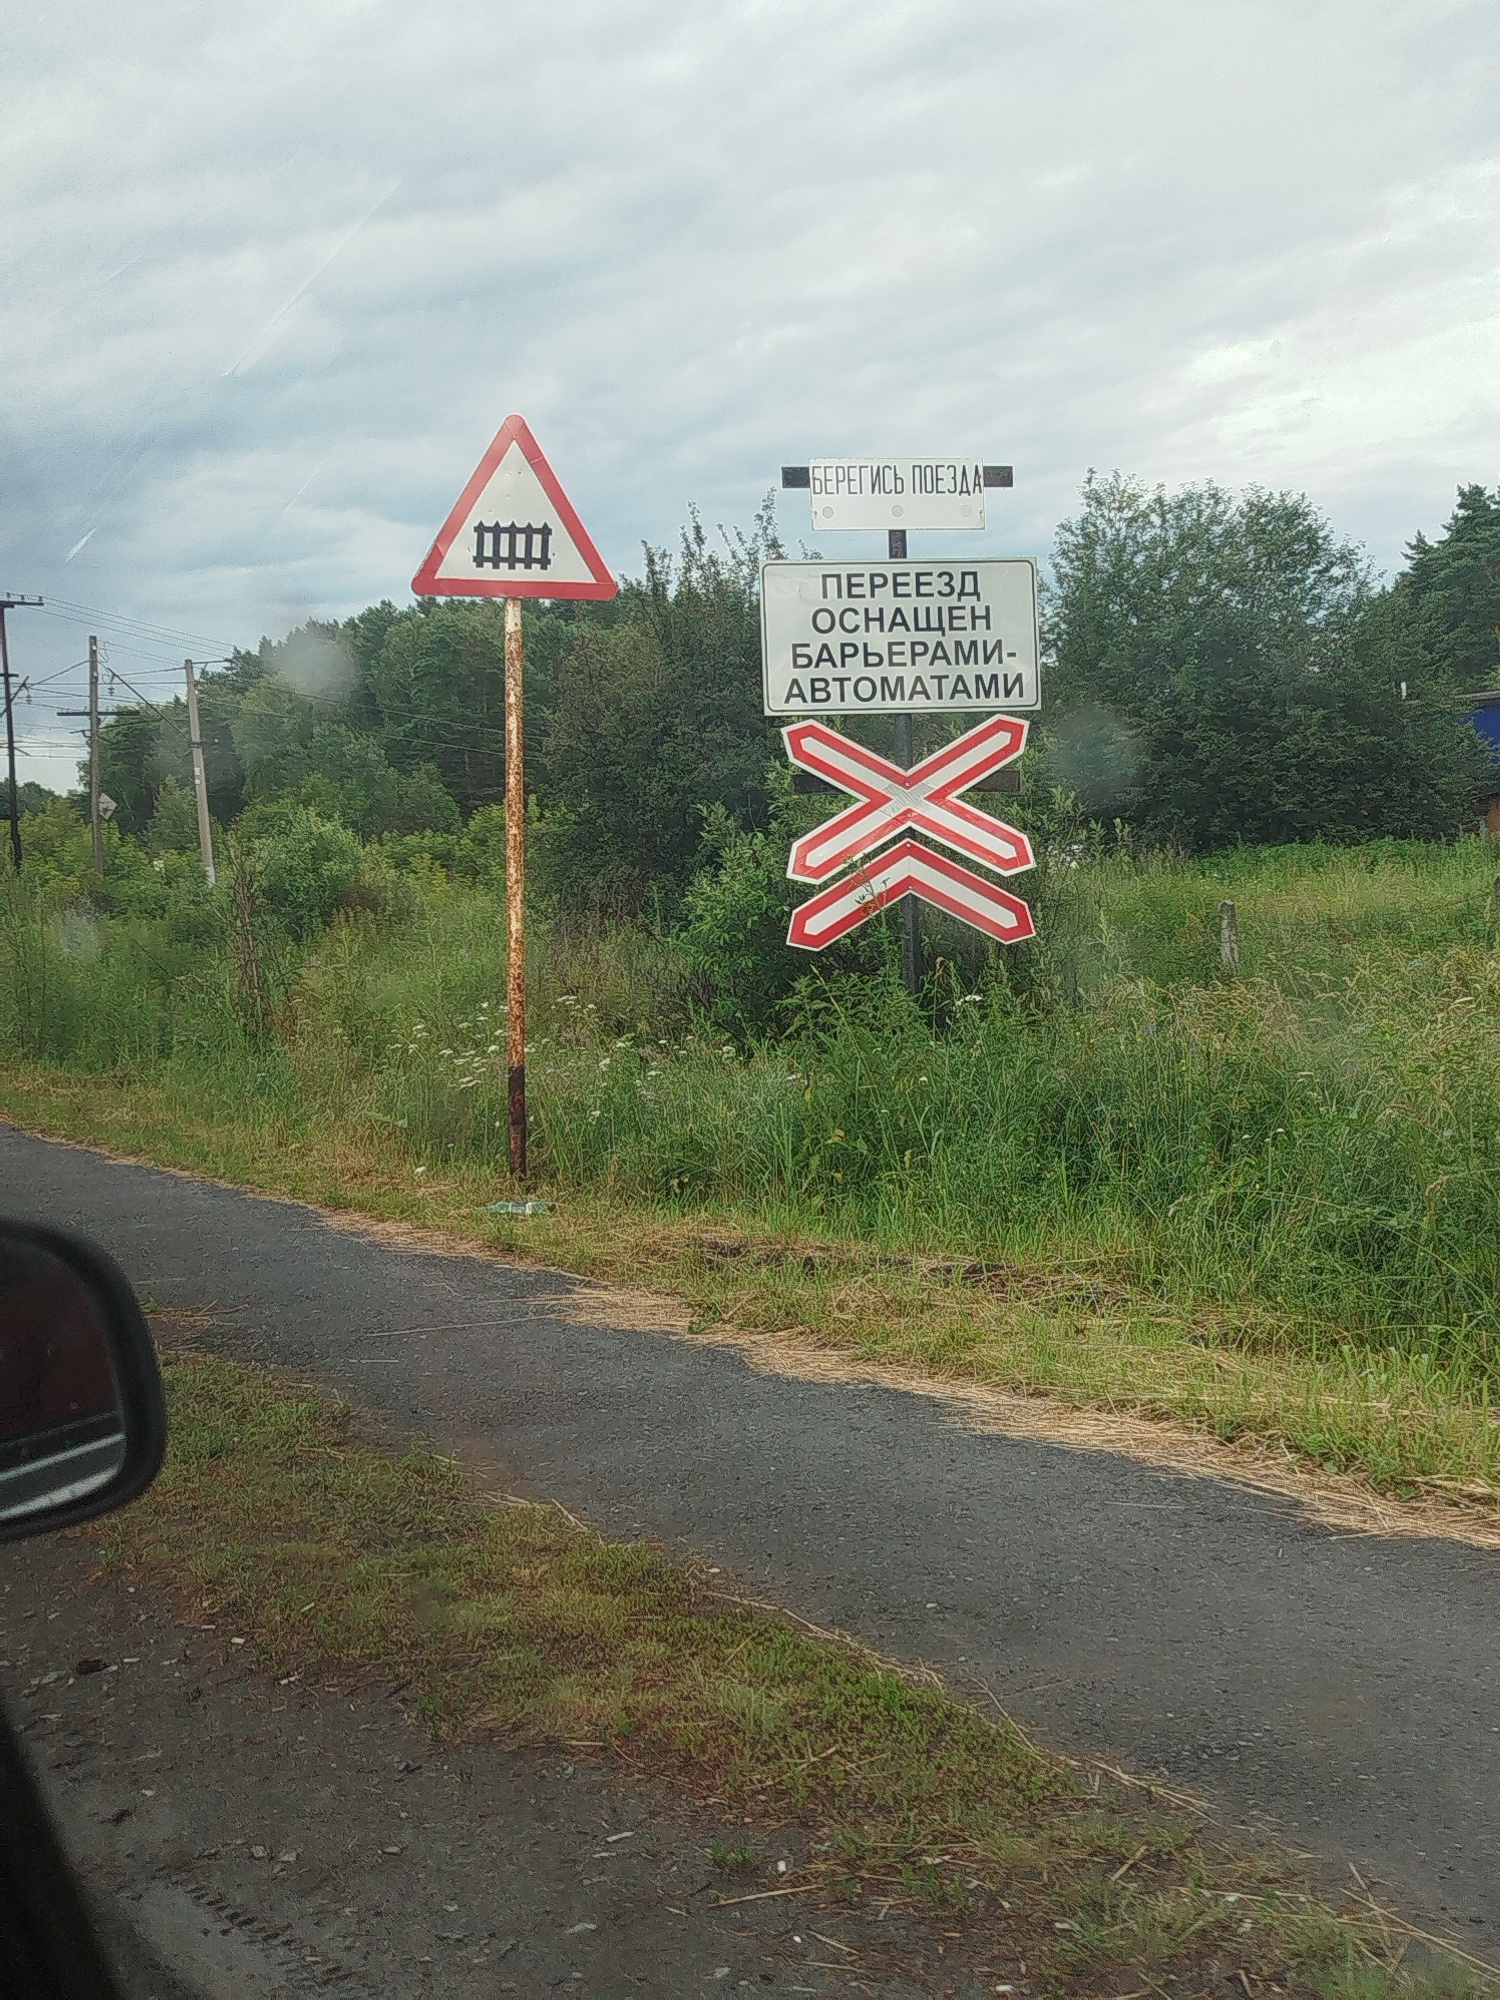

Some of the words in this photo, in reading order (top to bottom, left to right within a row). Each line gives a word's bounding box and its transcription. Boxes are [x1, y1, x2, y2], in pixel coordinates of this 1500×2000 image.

[812, 464, 904, 495] БЕРЕГИСЬ
[912, 464, 983, 496] ПОЕЗДА
[821, 571, 981, 602] ПЕРЕЕЗД
[811, 605, 991, 636] ОСНАЩЕН
[791, 639, 1017, 669] БАРЬЕРАМИ-
[783, 672, 1024, 704] АВТОМАТАМИ
